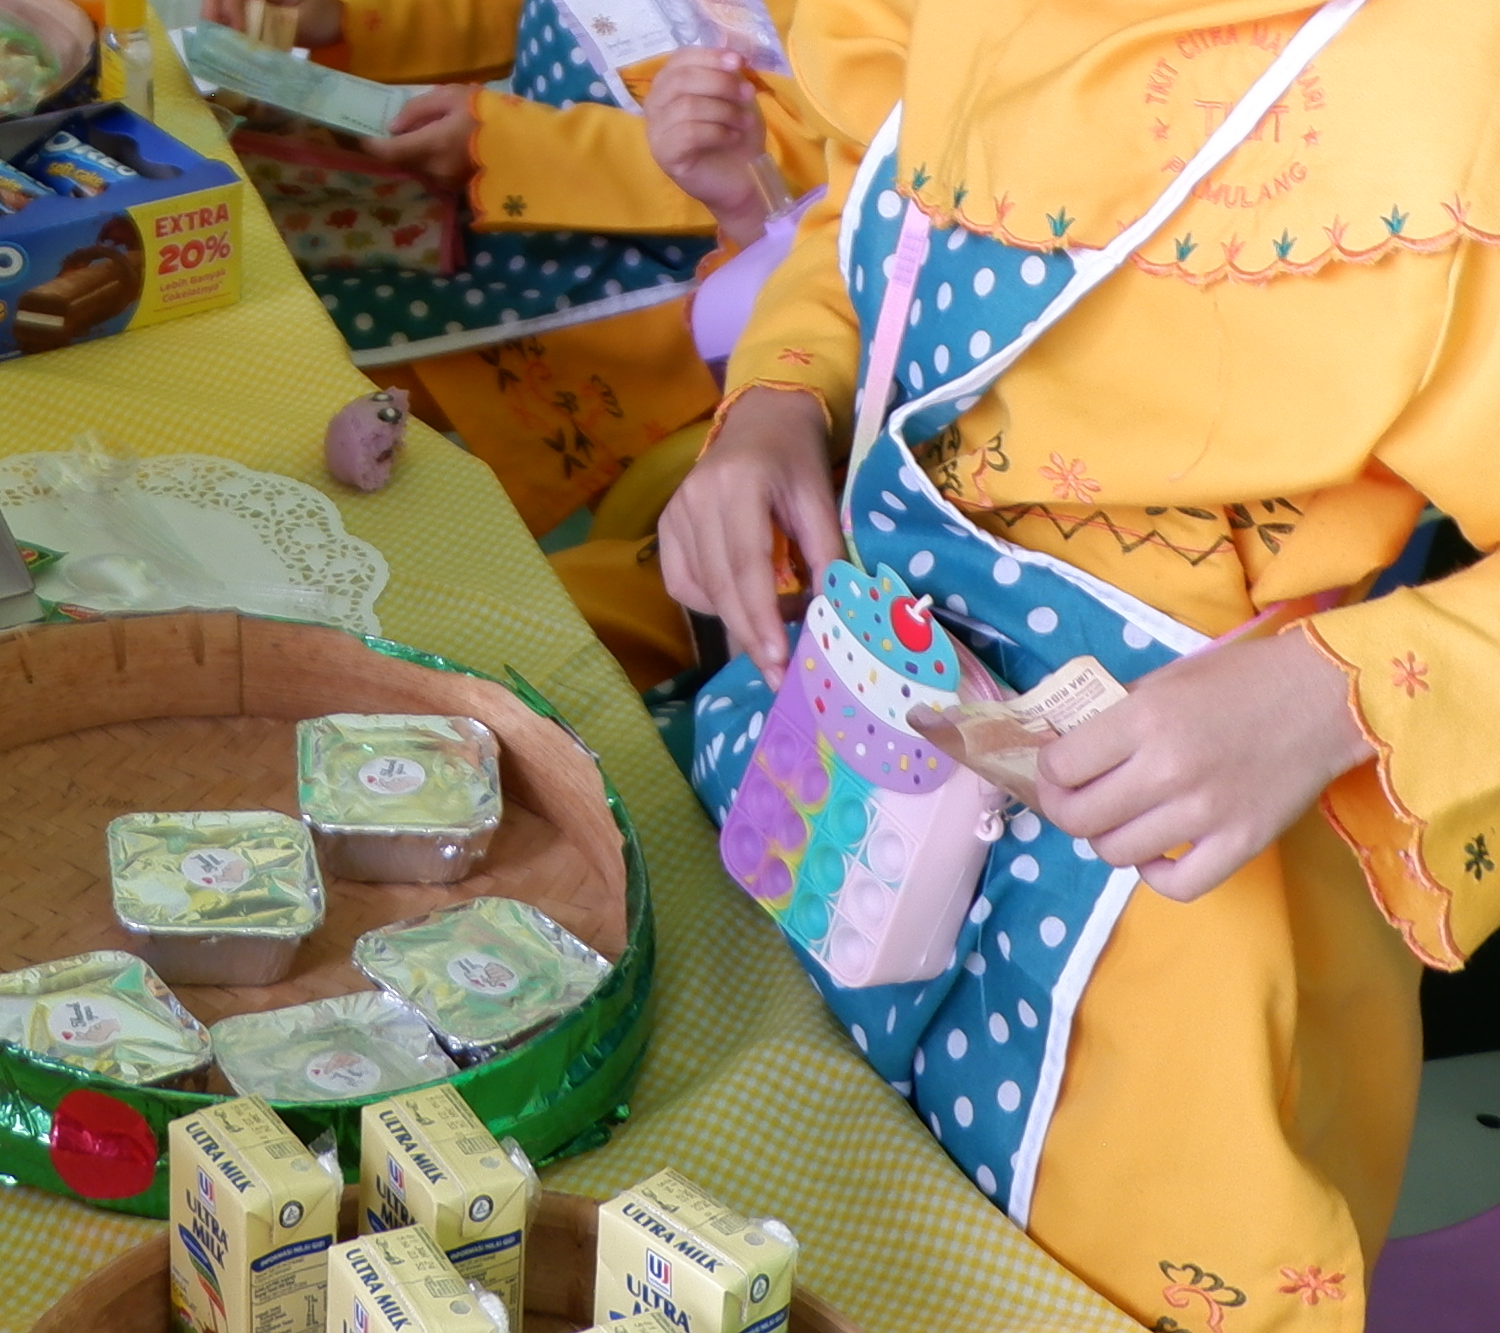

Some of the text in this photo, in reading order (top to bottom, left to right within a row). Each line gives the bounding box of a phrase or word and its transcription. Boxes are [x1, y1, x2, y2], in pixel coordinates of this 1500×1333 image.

[1145, 23, 1326, 111] TKIT CITRA MAARI
[1193, 99, 1289, 143] TT
[1161, 155, 1308, 209] PMULANG
[155, 202, 230, 238] EXTRA
[158, 231, 232, 275] 20%
[1069, 668, 1094, 690] LIMA
[185, 1121, 226, 1163] ULTRA
[217, 1157, 255, 1193] MILK
[379, 1109, 418, 1153] ULTRA
[409, 1149, 448, 1185] MILK
[185, 1189, 229, 1251] ULTRA
[192, 1216, 226, 1270] MILK
[622, 1202, 724, 1273] ULTRA MILK
[346, 1248, 413, 1332] ULTRA MILK
[626, 1273, 690, 1333] ULTRA
